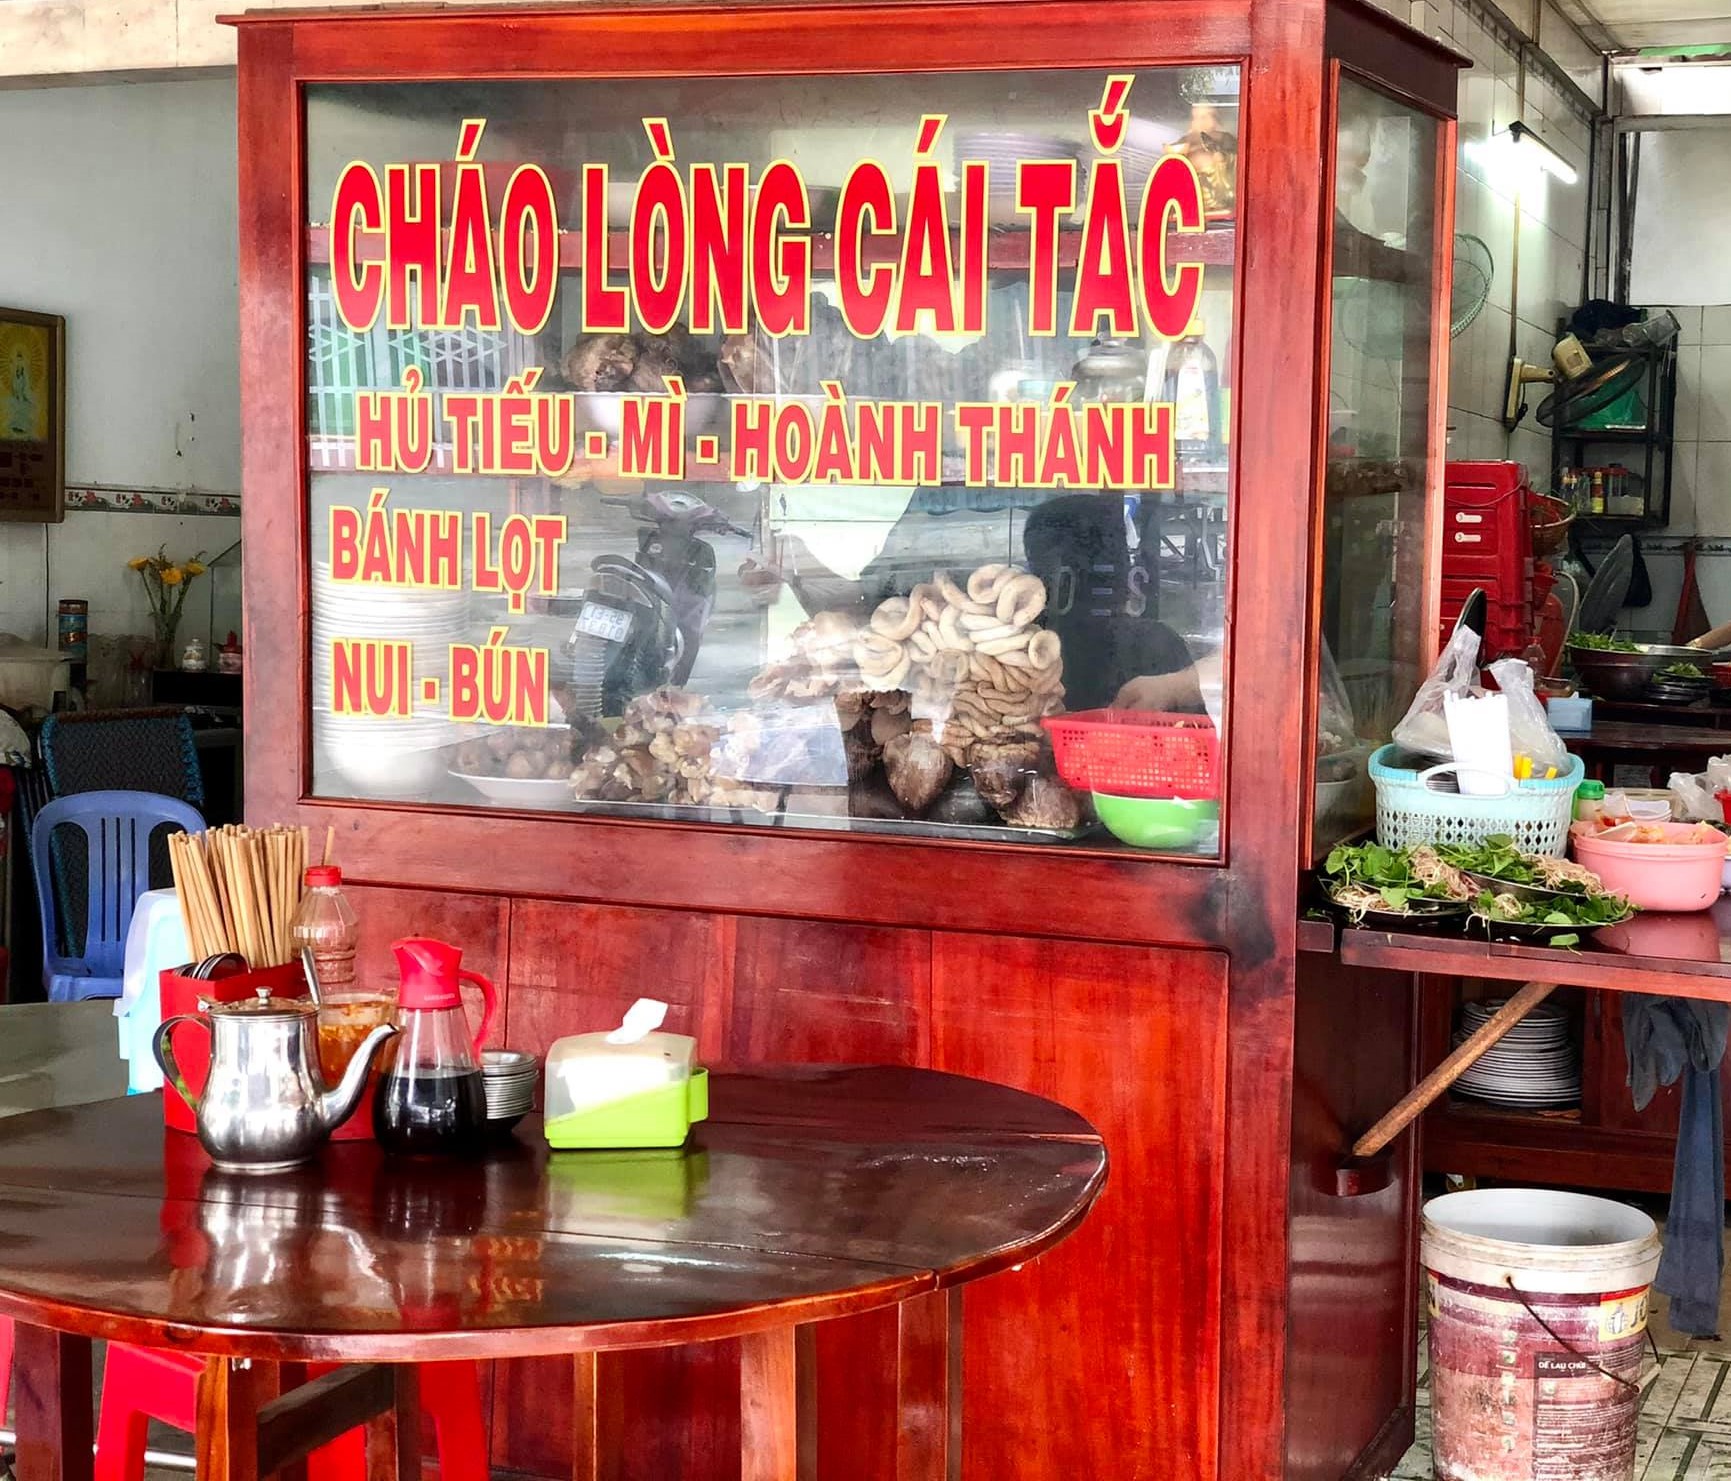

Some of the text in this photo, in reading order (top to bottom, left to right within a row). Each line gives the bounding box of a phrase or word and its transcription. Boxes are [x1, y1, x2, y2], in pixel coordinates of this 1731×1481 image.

[330, 74, 1205, 342] CHÁO LÒNG CÁI TẮC
[355, 367, 433, 473] HỦ
[443, 367, 574, 477] TIẾU
[617, 375, 686, 480] MÌ
[729, 380, 941, 486] HOÀNH
[953, 380, 1177, 490] THÁNH
[329, 487, 567, 614] BÁNH LỌT
[330, 637, 413, 720] NUI
[448, 626, 549, 728] BÚN
